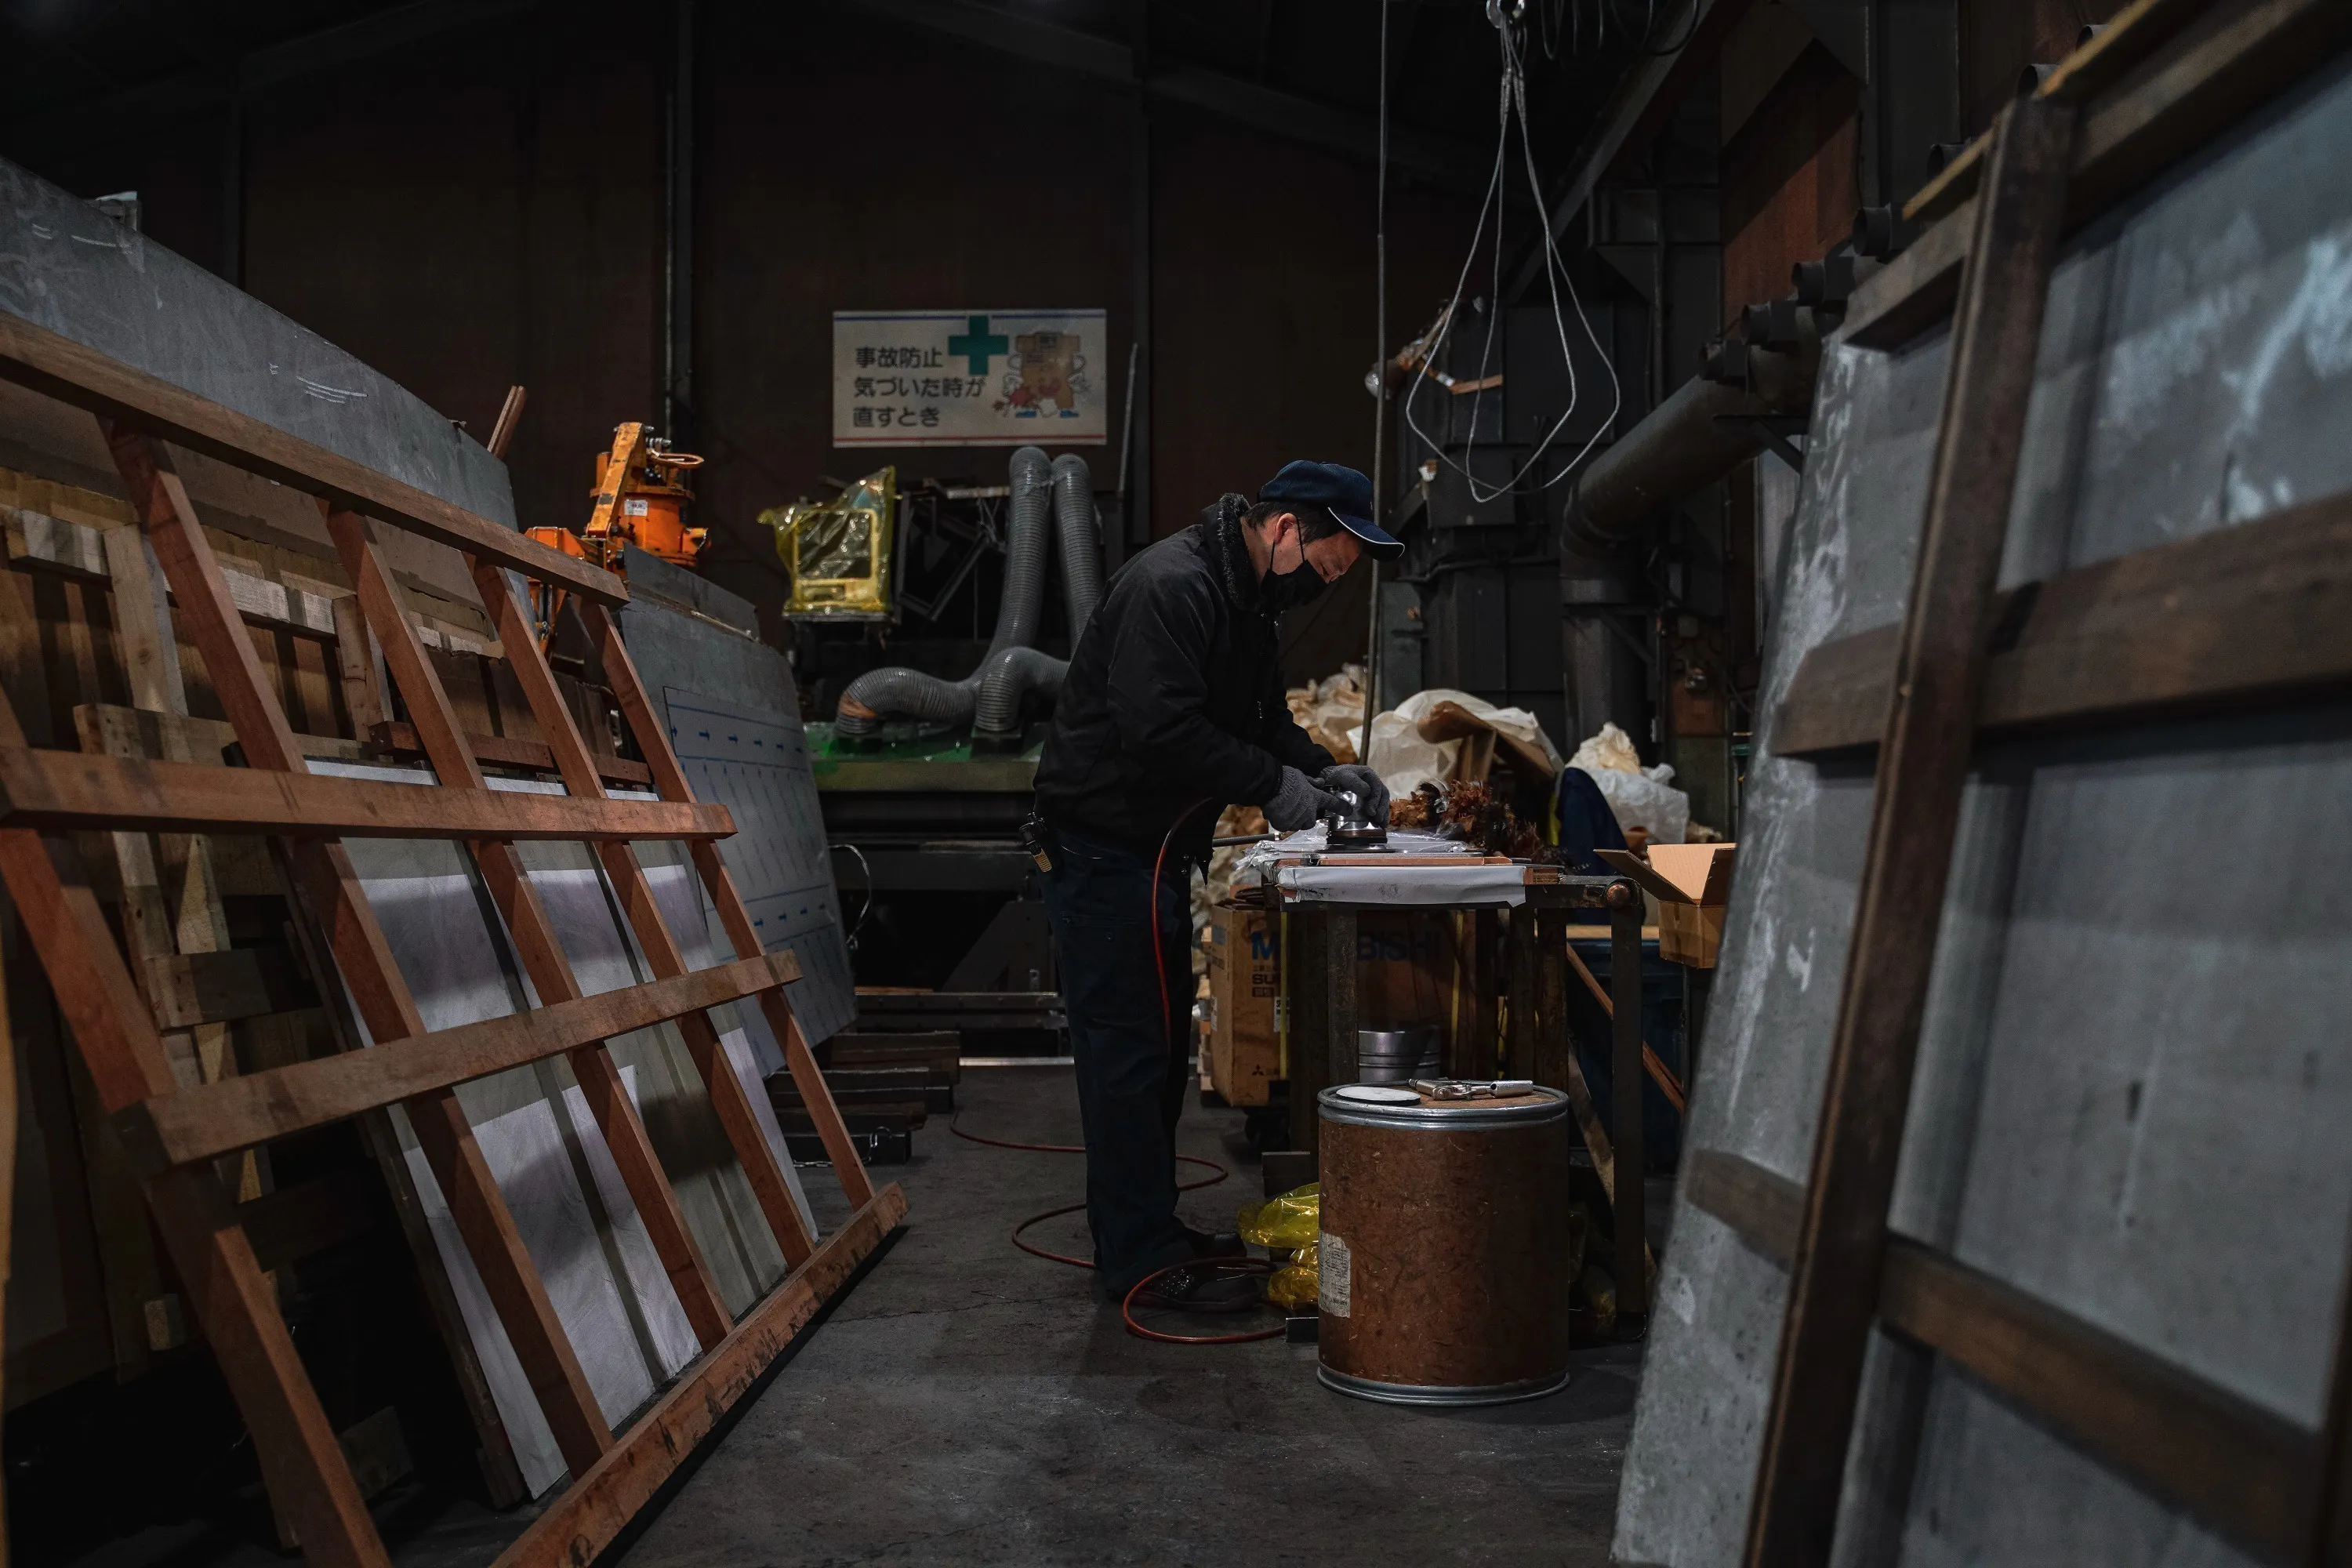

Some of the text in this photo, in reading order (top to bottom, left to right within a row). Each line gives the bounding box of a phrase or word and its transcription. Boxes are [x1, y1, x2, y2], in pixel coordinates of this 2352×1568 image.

[855, 347, 944, 369] 事故防止
[854, 376, 985, 398] 気づいた時が
[853, 407, 940, 428] 直すとき
